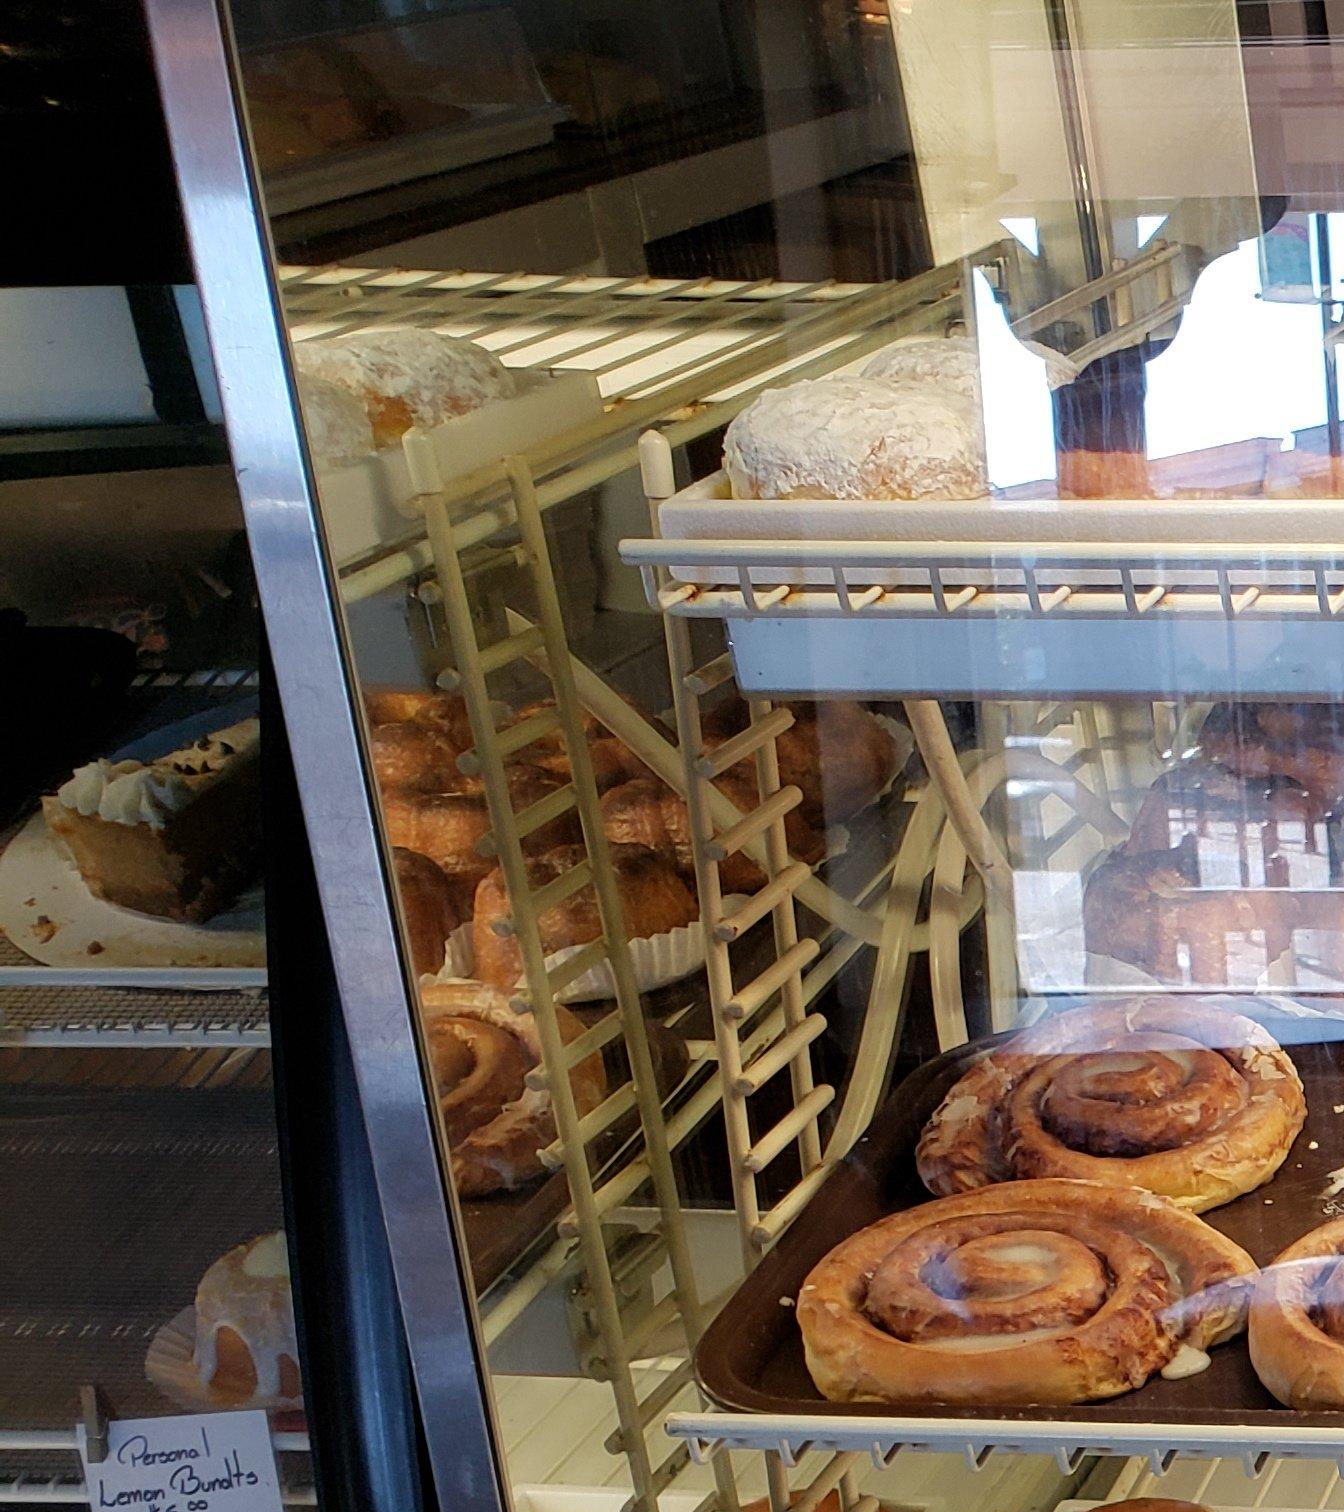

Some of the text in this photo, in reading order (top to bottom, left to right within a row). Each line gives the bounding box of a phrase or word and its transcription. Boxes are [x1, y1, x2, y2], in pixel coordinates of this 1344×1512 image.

[117, 1426, 210, 1467] Personal
[99, 1448, 259, 1508] Lemon Bundts
